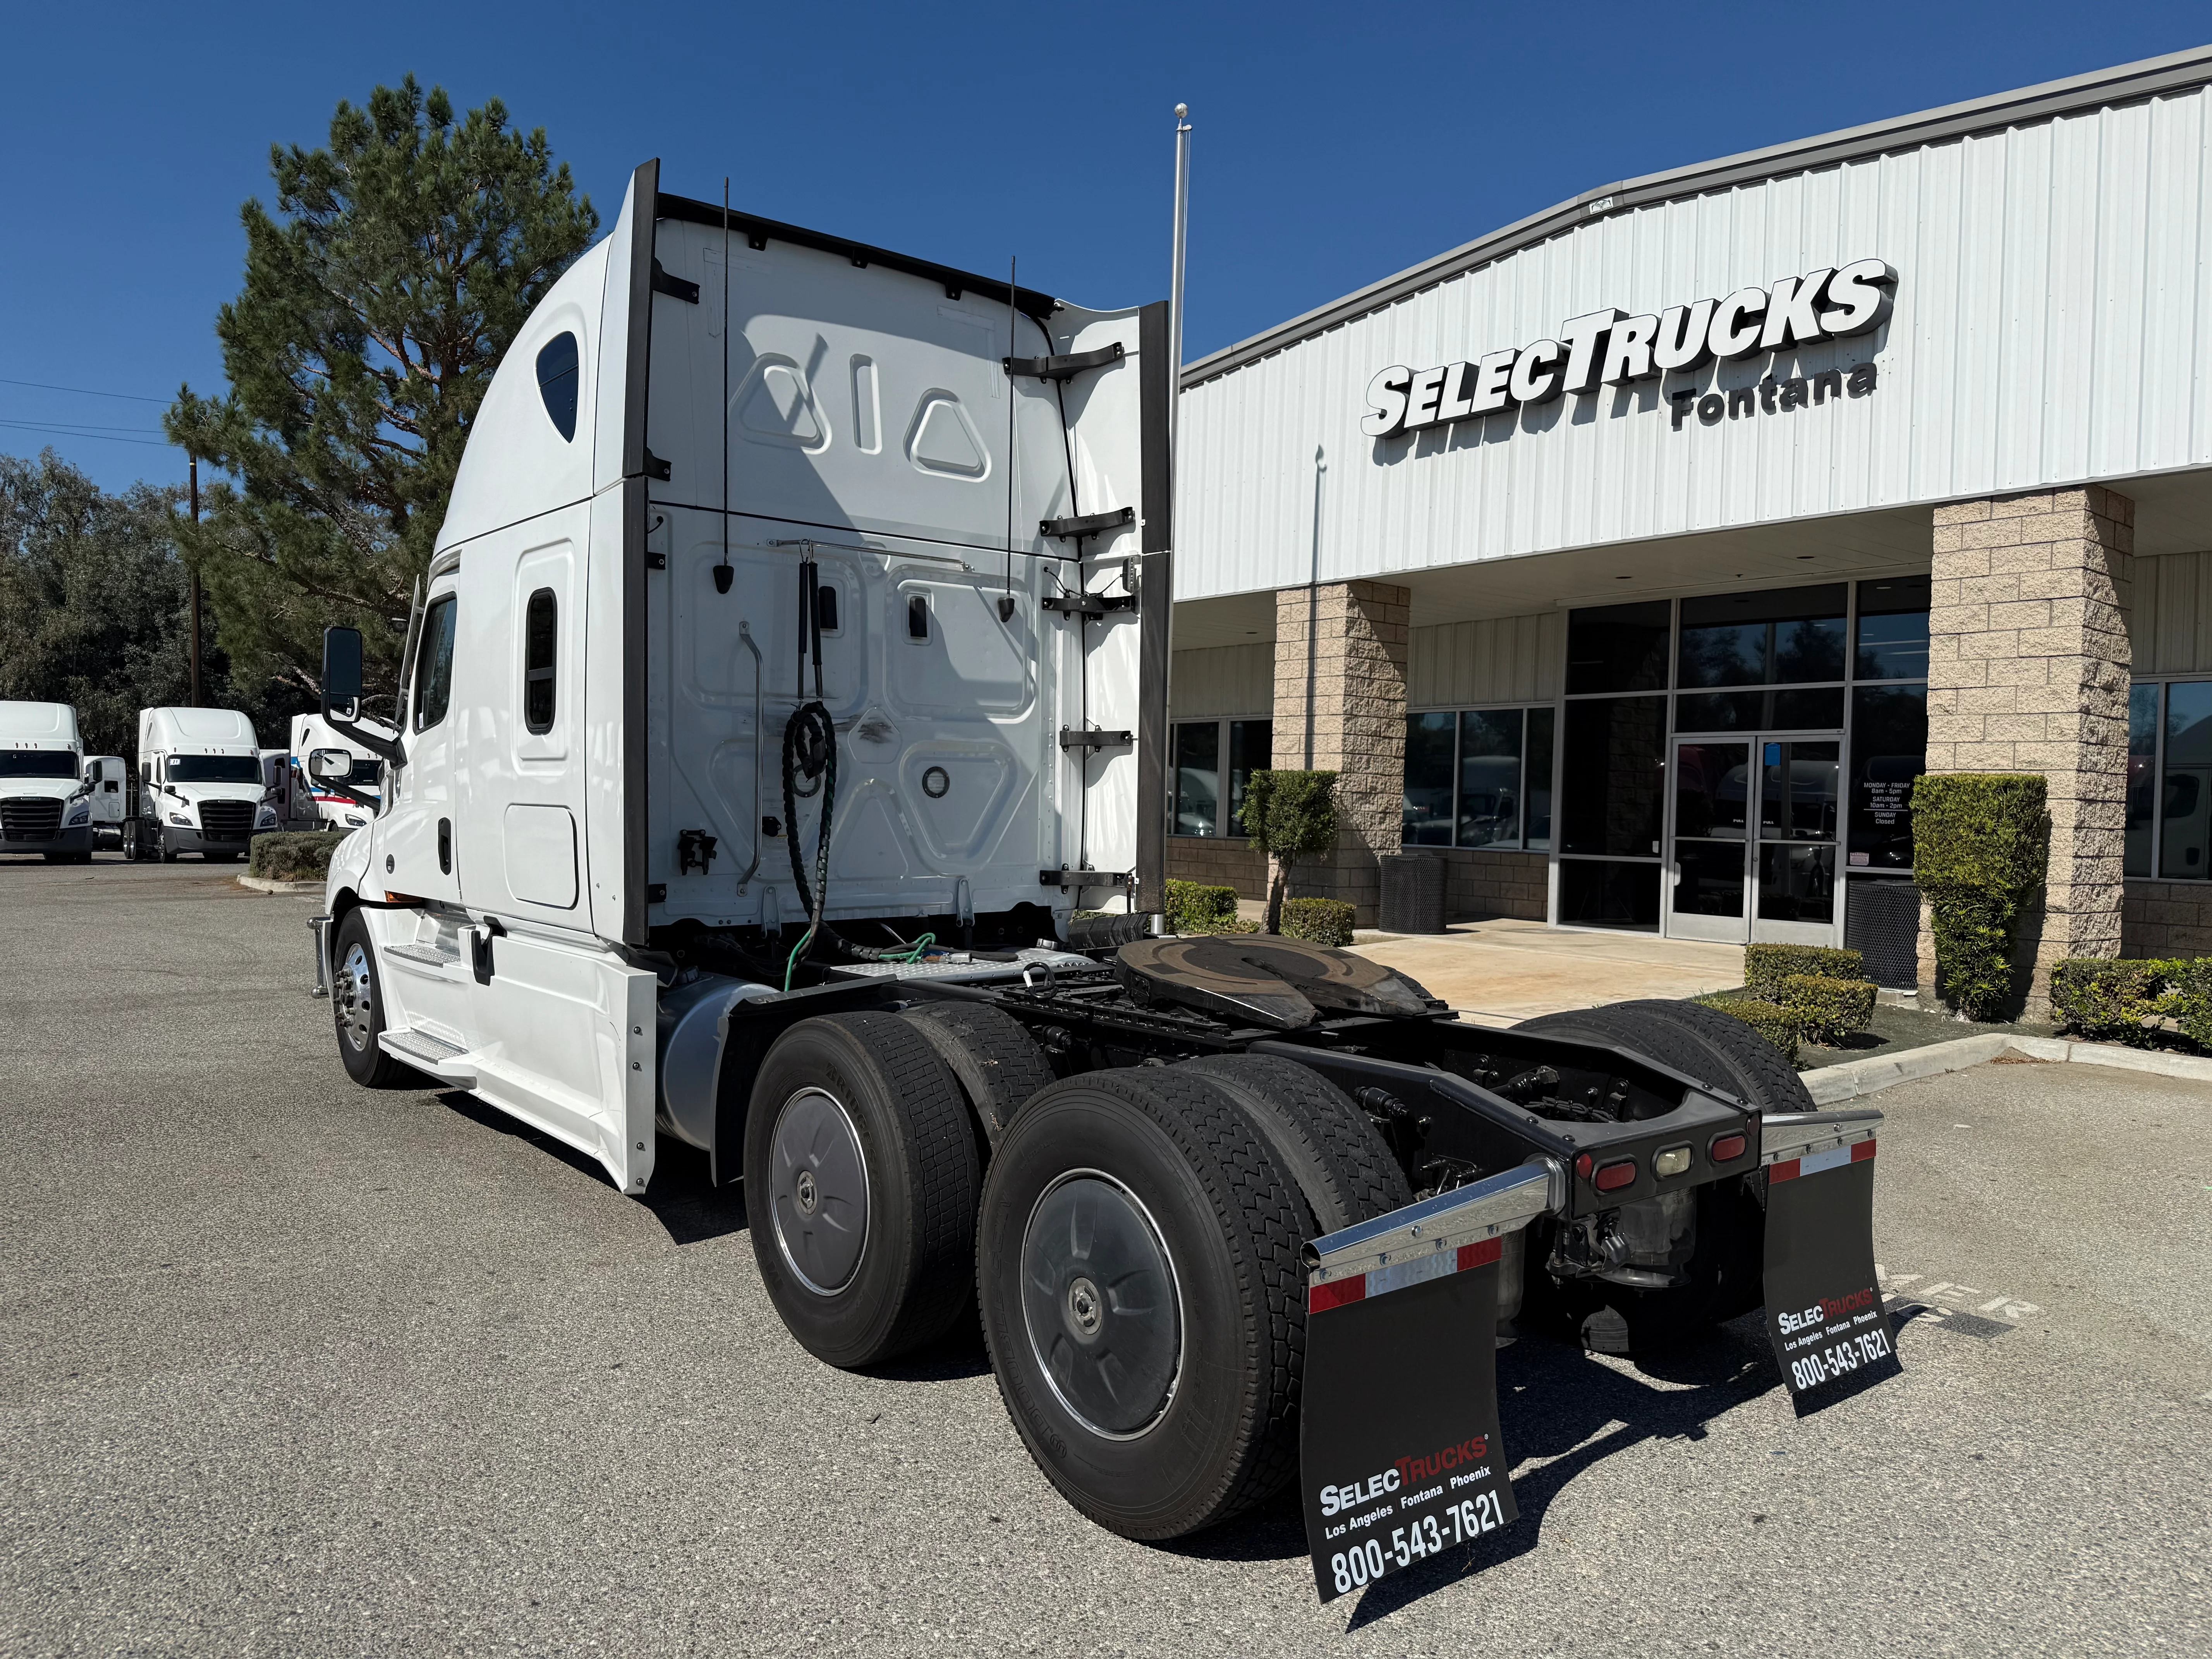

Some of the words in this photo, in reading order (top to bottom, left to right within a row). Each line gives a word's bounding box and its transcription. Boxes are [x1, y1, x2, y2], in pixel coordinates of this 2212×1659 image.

[1671, 361, 1879, 432] Fontana
[1784, 1341, 1797, 1351] Los
[1798, 1331, 1822, 1346] Angeles
[1826, 1321, 1850, 1335] Fontana
[1853, 1310, 1877, 1325] Phoenix
[1791, 1328, 1891, 1390] 800-543-7621
[1325, 1522, 1346, 1539] Los
[1350, 1504, 1393, 1530] Angeles
[1400, 1485, 1443, 1509] Fontana
[1450, 1466, 1491, 1489] Phoenix
[1331, 1489, 1504, 1593] 800-543-7621
